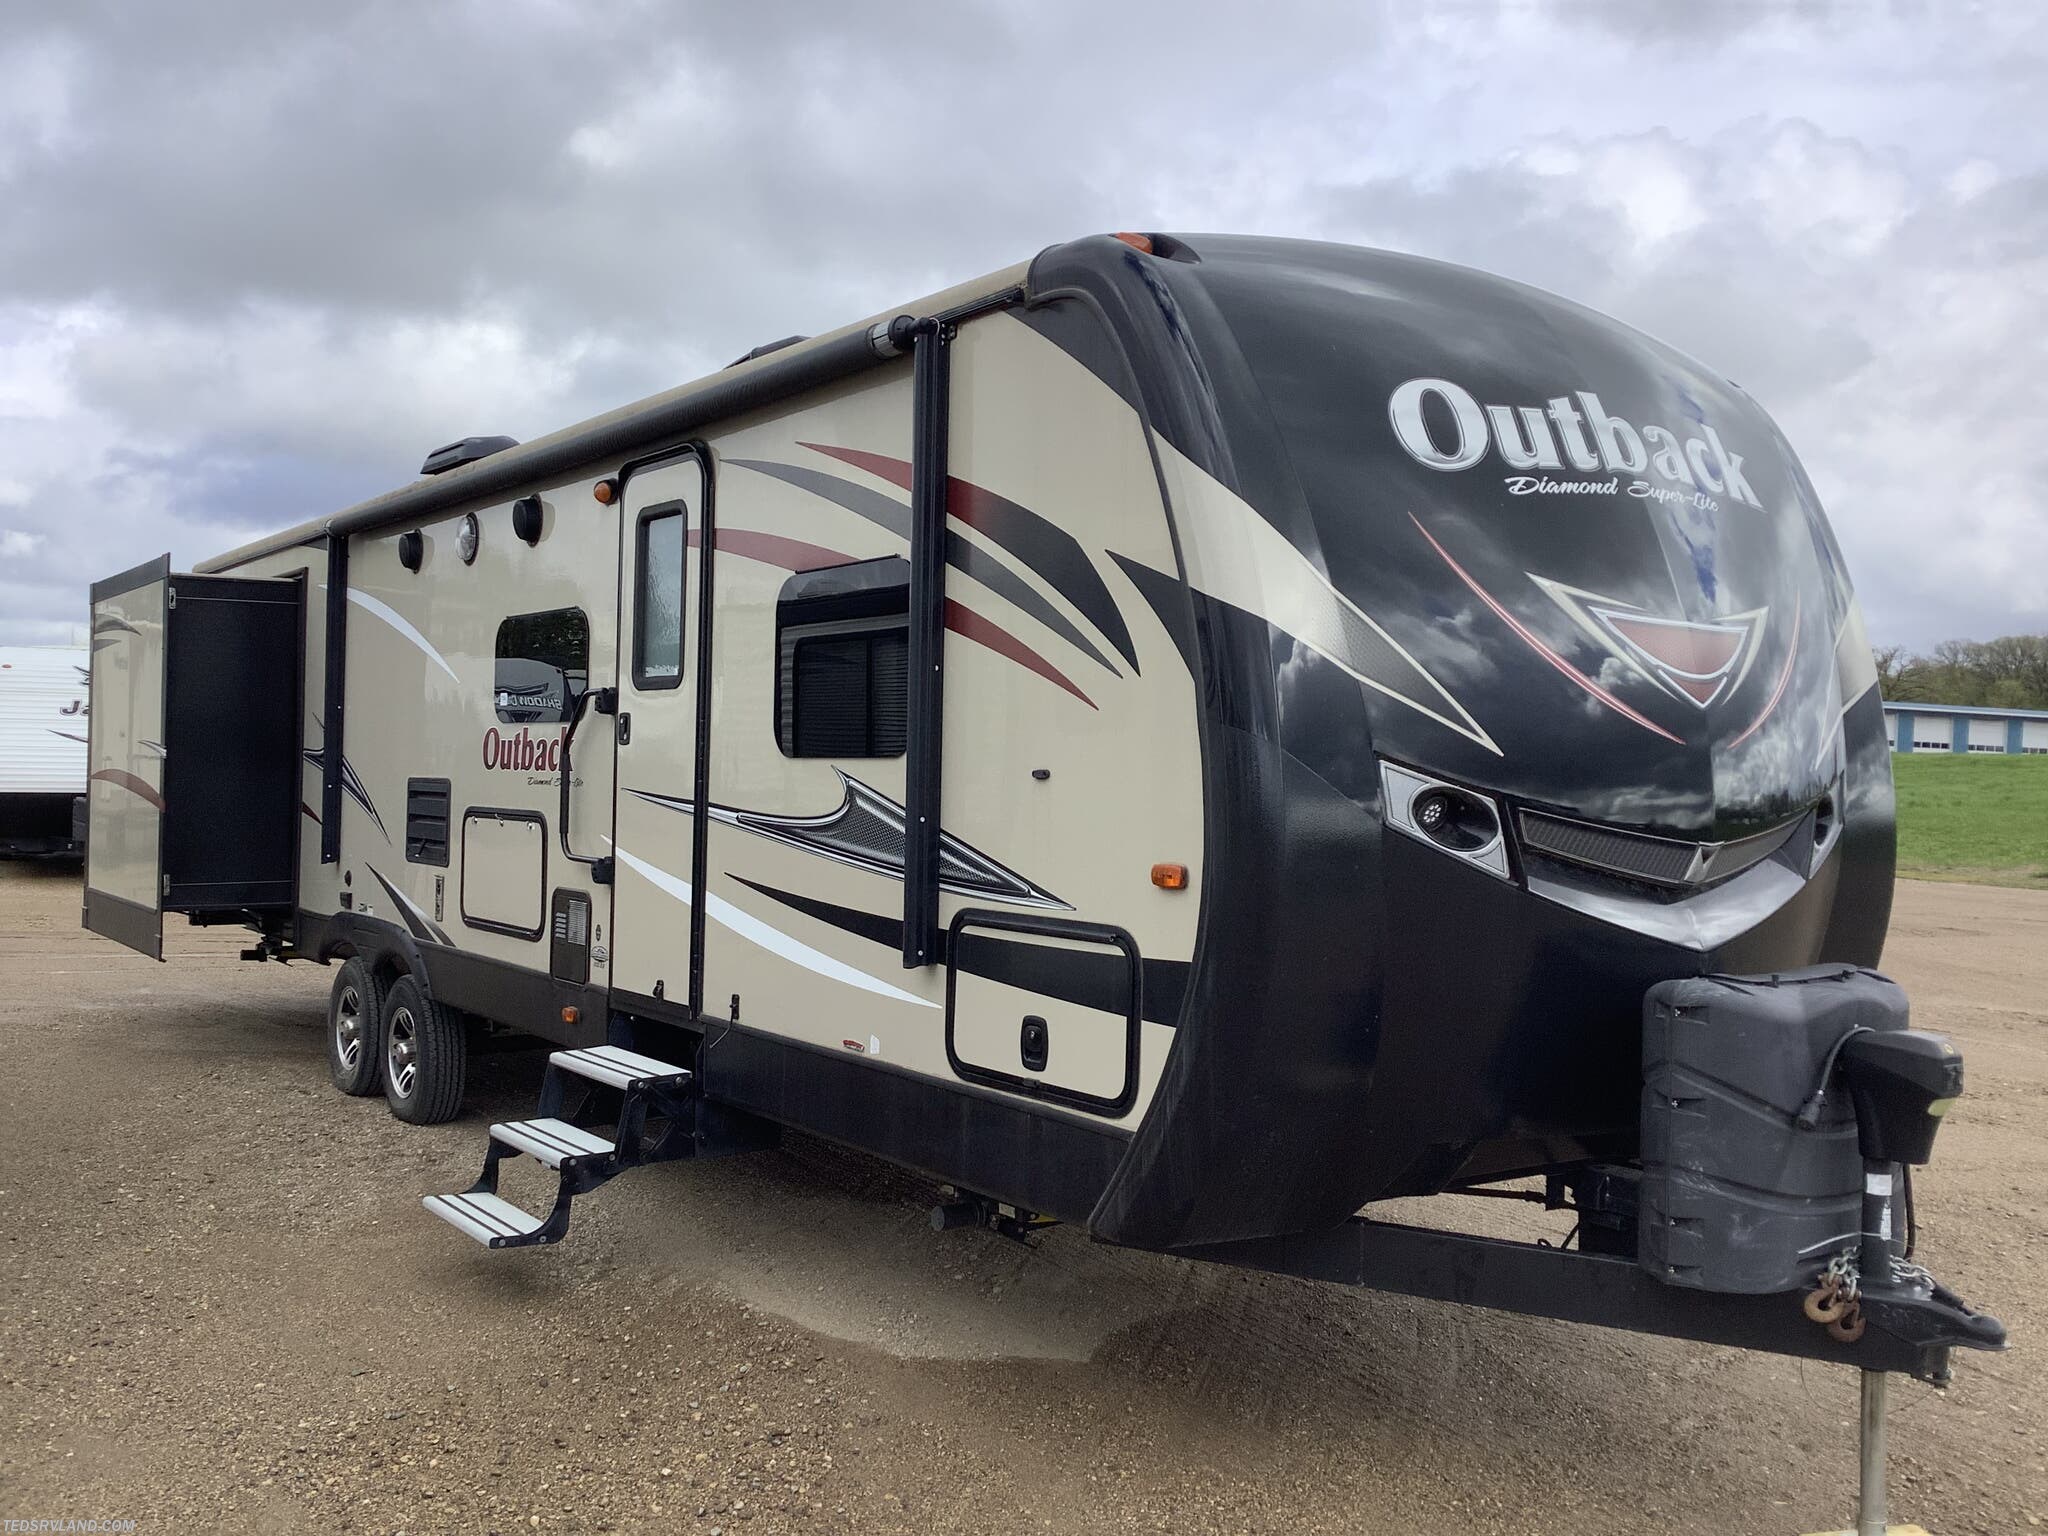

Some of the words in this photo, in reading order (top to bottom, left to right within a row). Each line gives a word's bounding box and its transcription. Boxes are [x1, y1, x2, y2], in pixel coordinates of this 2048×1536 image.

[1388, 377, 1767, 512] Outback
[1504, 476, 1619, 495] Diamond
[1627, 480, 1720, 512] Super-Lite
